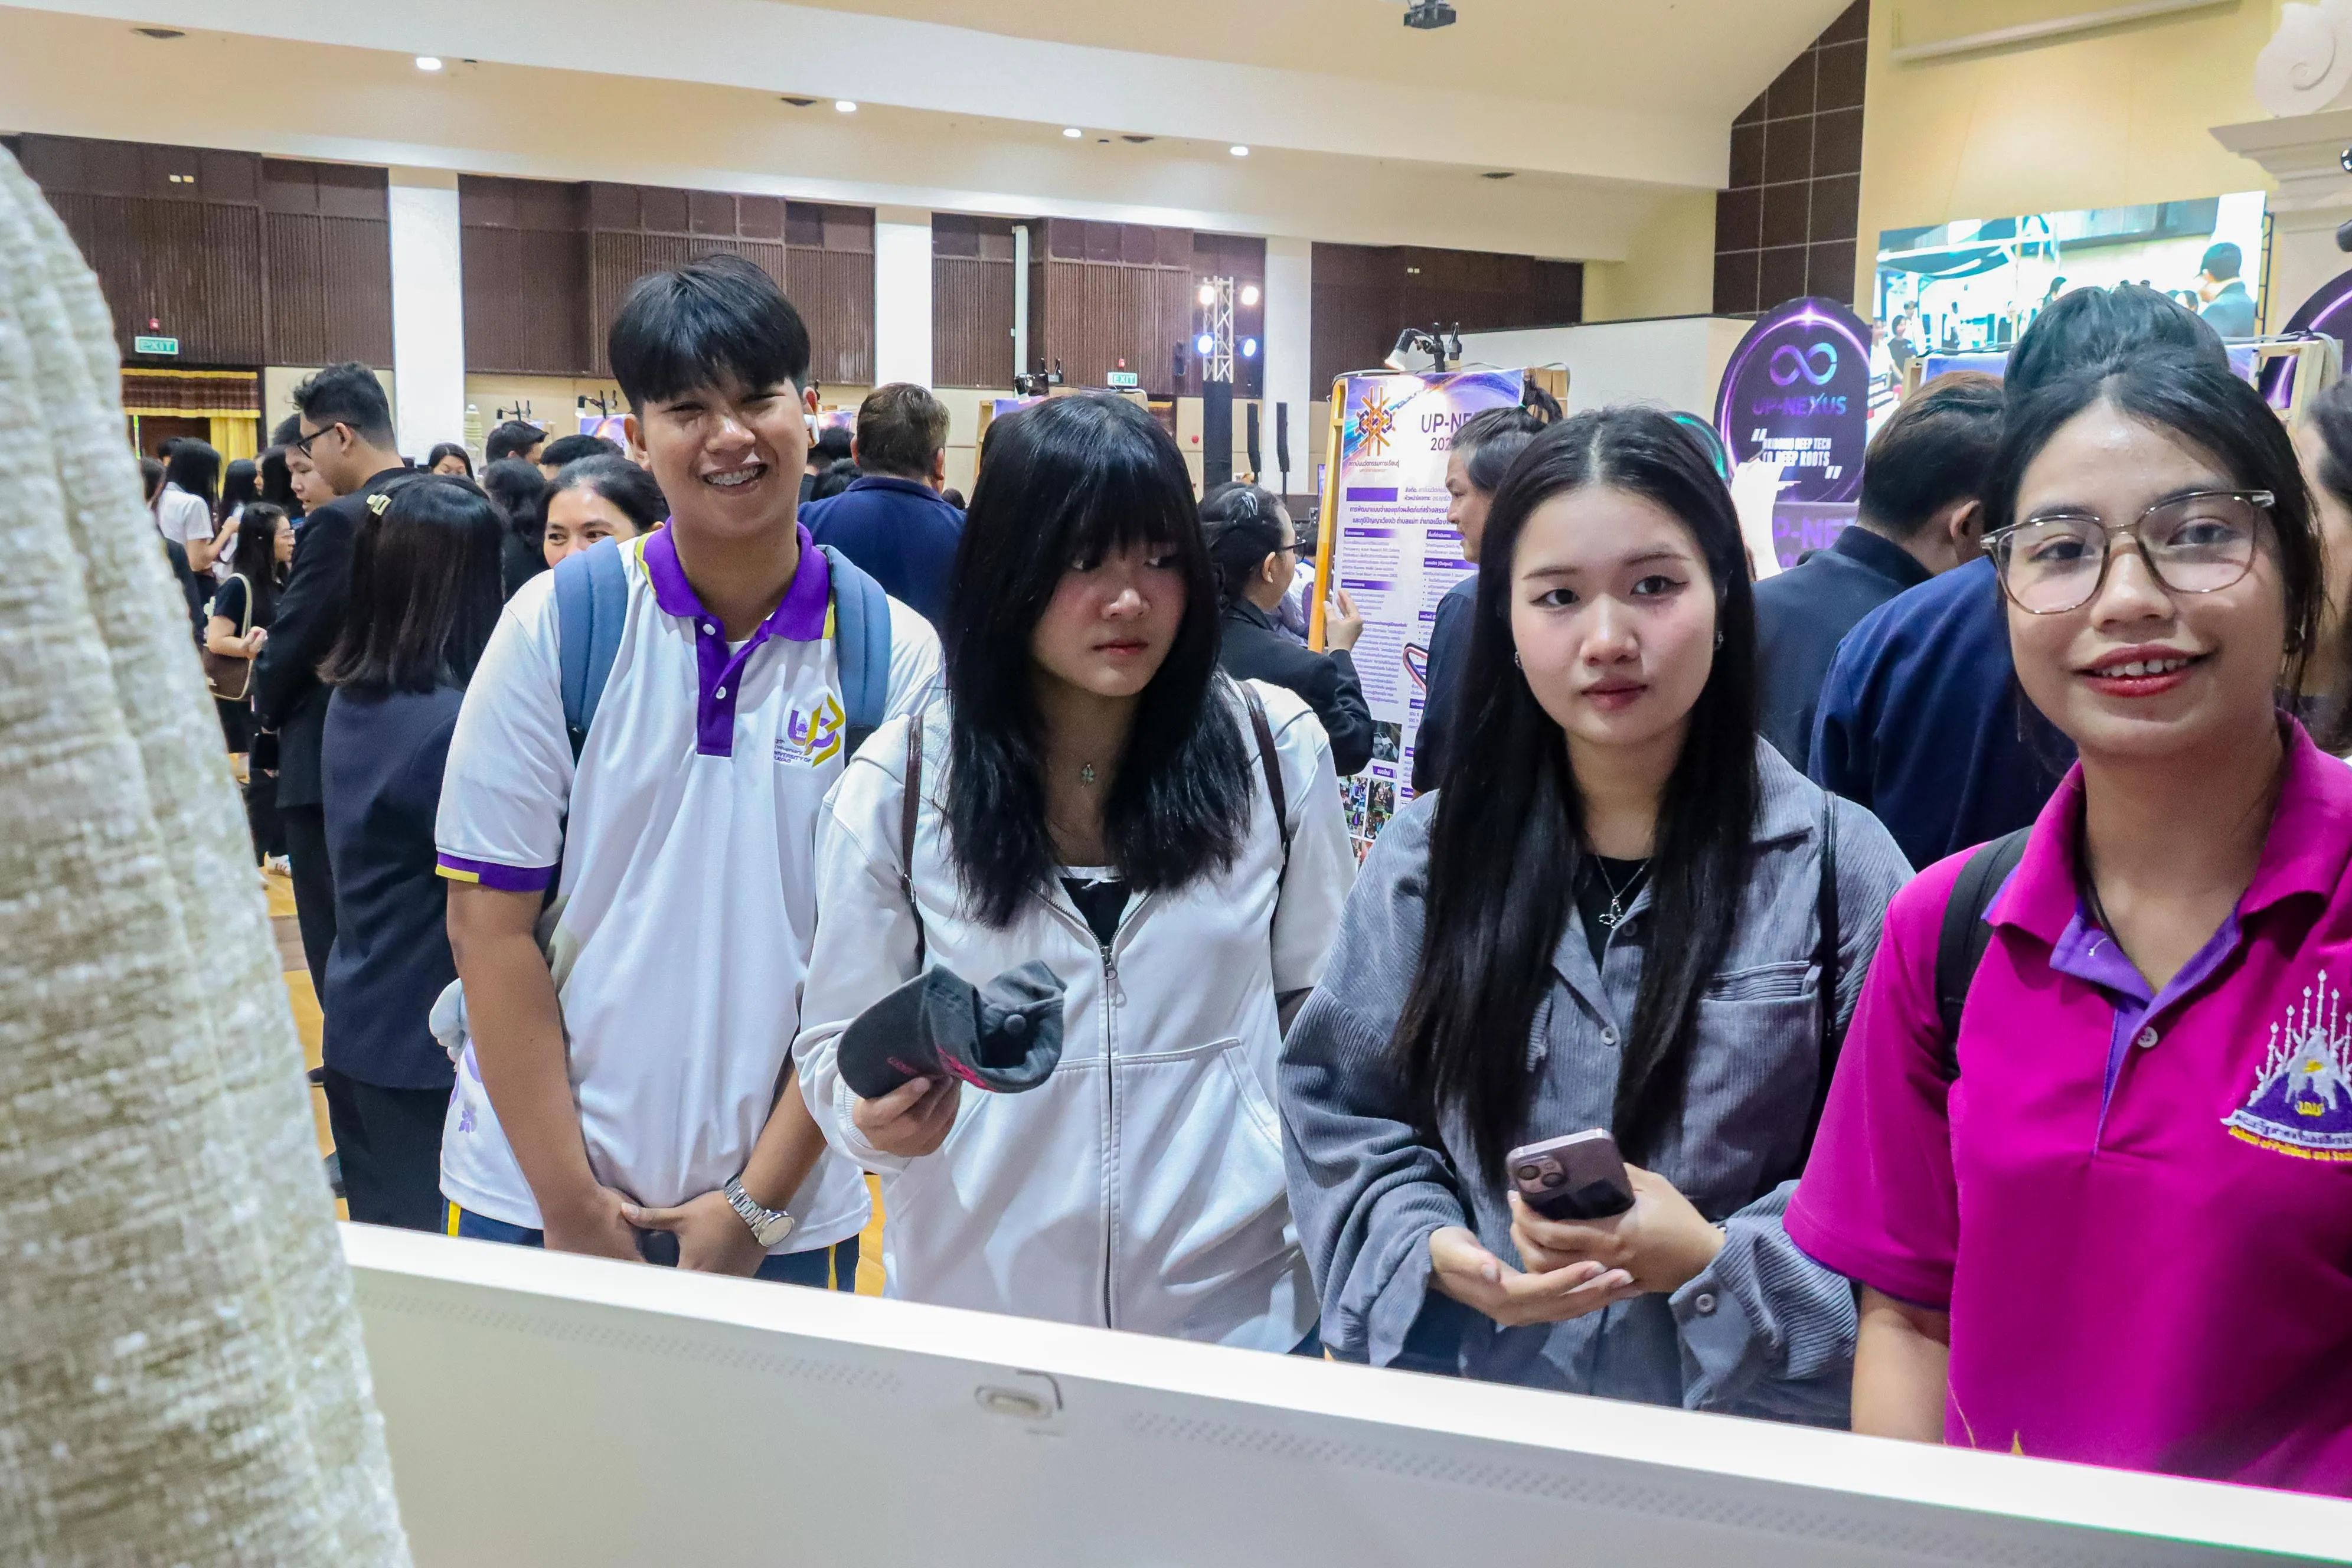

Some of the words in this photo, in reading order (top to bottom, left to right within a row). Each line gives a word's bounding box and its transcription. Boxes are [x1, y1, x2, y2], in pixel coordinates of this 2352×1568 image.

[141, 339, 175, 351] EXIT
[1114, 375, 1135, 384] EXIT
[1752, 393, 1847, 417] UP-NEXUS
[1430, 437, 1452, 451] 202
[1814, 437, 1832, 450] TECH
[1799, 451, 1831, 467] ROOTS
